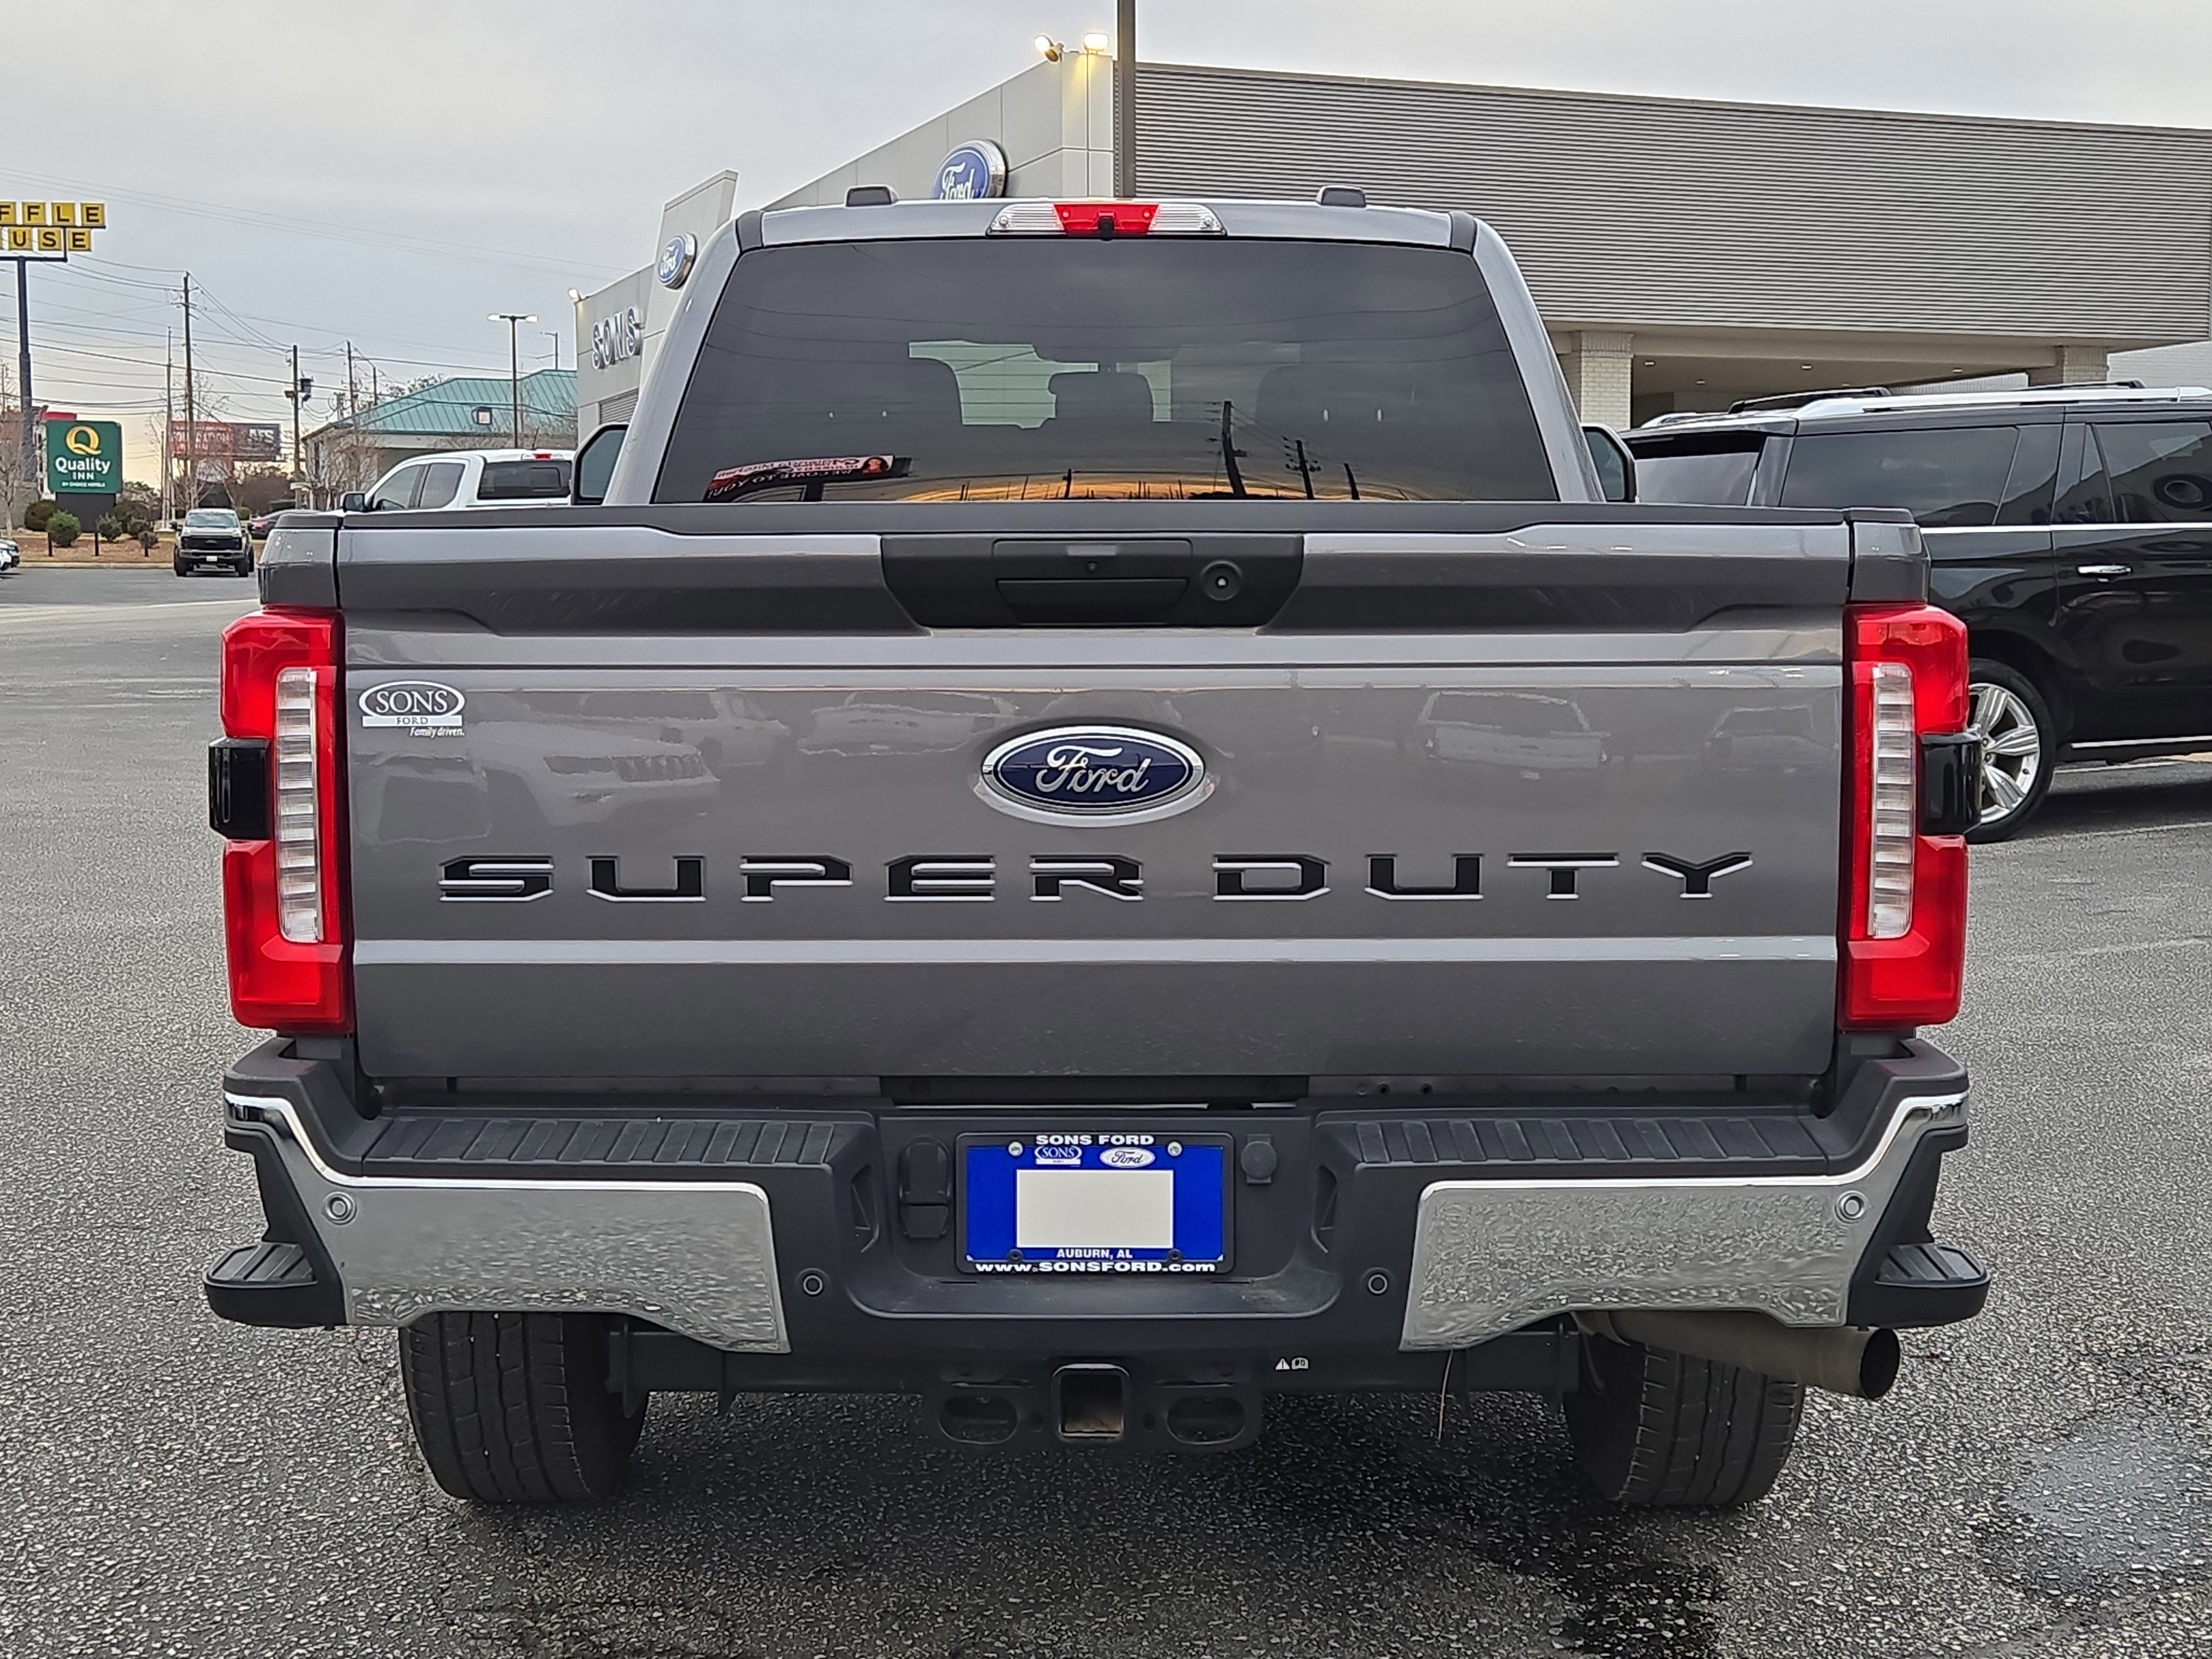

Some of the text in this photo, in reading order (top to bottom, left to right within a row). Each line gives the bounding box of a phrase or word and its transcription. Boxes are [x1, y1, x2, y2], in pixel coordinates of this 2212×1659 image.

[592, 306, 642, 370] SONS
[66, 425, 102, 455] Q
[55, 456, 111, 474] Quality
[72, 472, 95, 480] INN
[375, 690, 448, 713] SONS
[396, 716, 429, 725] FORD
[409, 726, 465, 738] Family driven.
[1035, 745, 1152, 793] Ford
[439, 852, 1753, 902] SUPER DUTY
[1036, 1135, 1155, 1146] SONS FORD
[1041, 1146, 1076, 1158] SONS
[1111, 1150, 1144, 1164] Ford
[1056, 1249, 1133, 1260] AUBURN, AL
[975, 1262, 1216, 1273] www.SONSFORD.com
